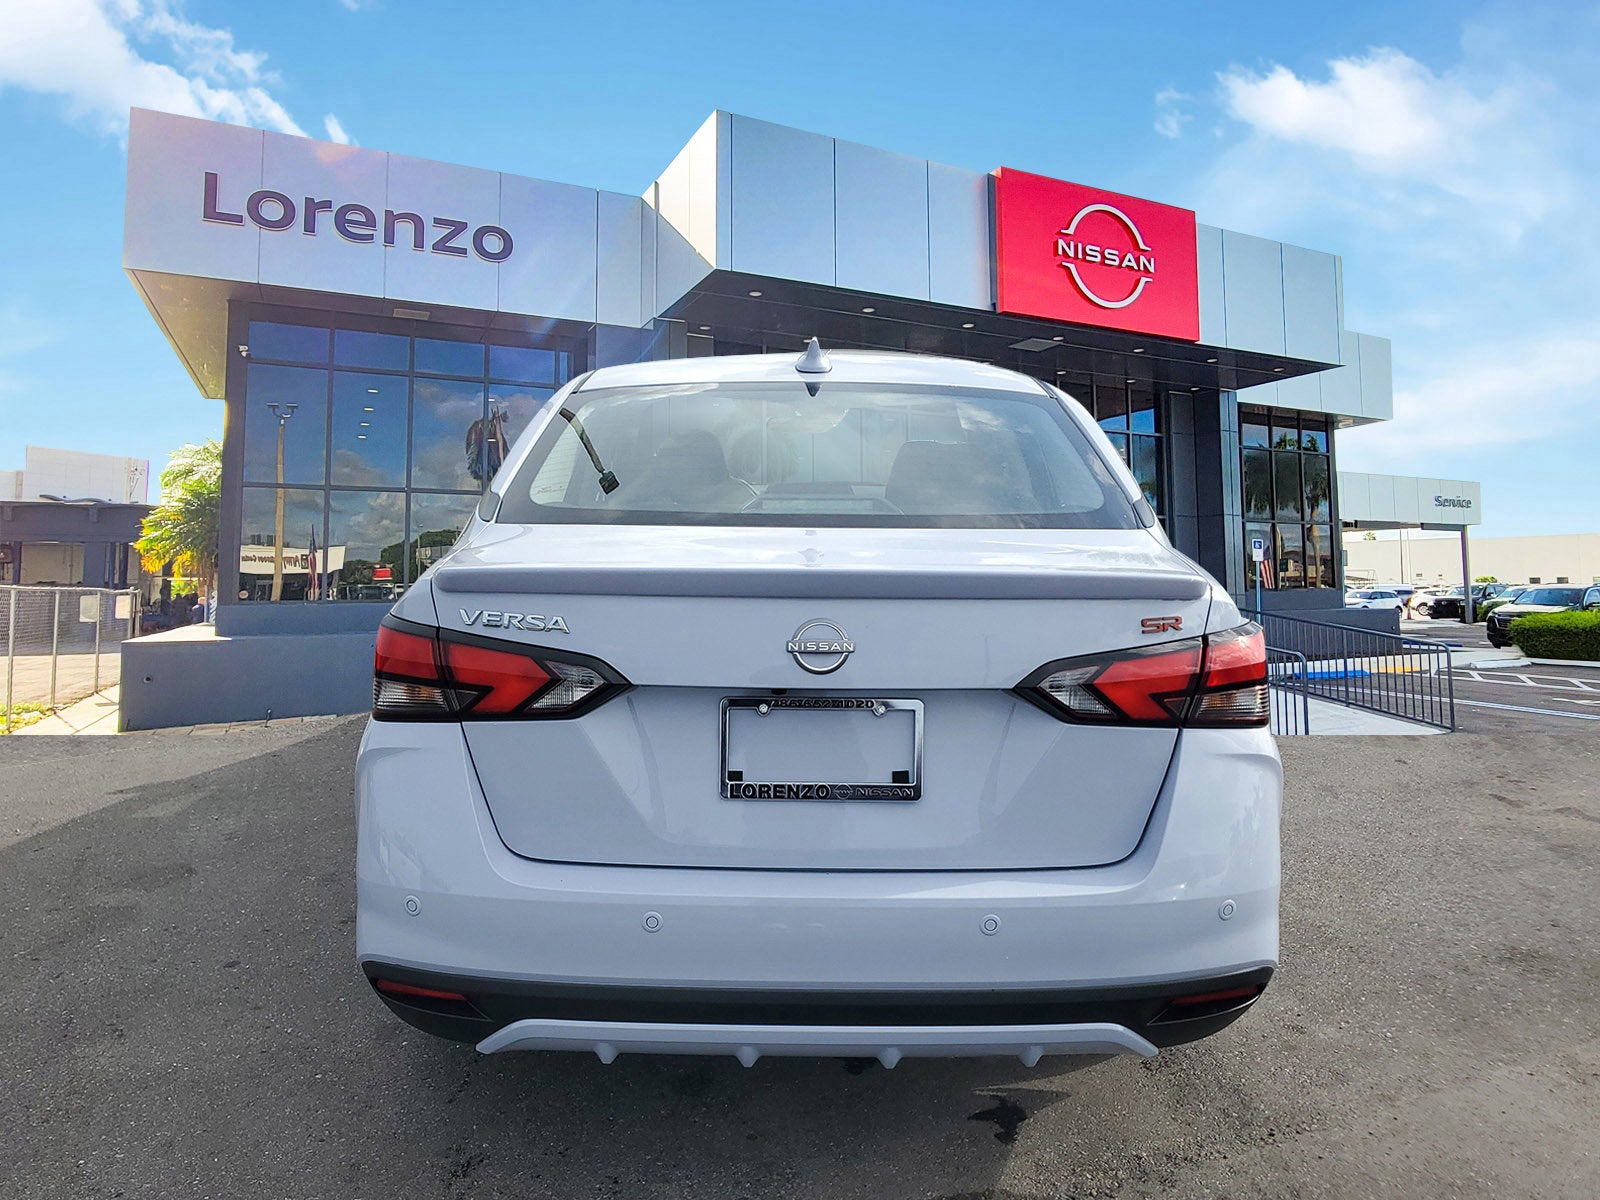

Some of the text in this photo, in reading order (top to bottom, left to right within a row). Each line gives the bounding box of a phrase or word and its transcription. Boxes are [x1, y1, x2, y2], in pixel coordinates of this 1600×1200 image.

[201, 170, 515, 263] Lorenzo
[1057, 238, 1155, 274] NISSAN
[1434, 495, 1472, 509] Service
[459, 608, 570, 634] VERSA
[1141, 615, 1184, 635] SR
[787, 642, 855, 652] NISSAN
[729, 783, 914, 800] LORENZO NISSAN
